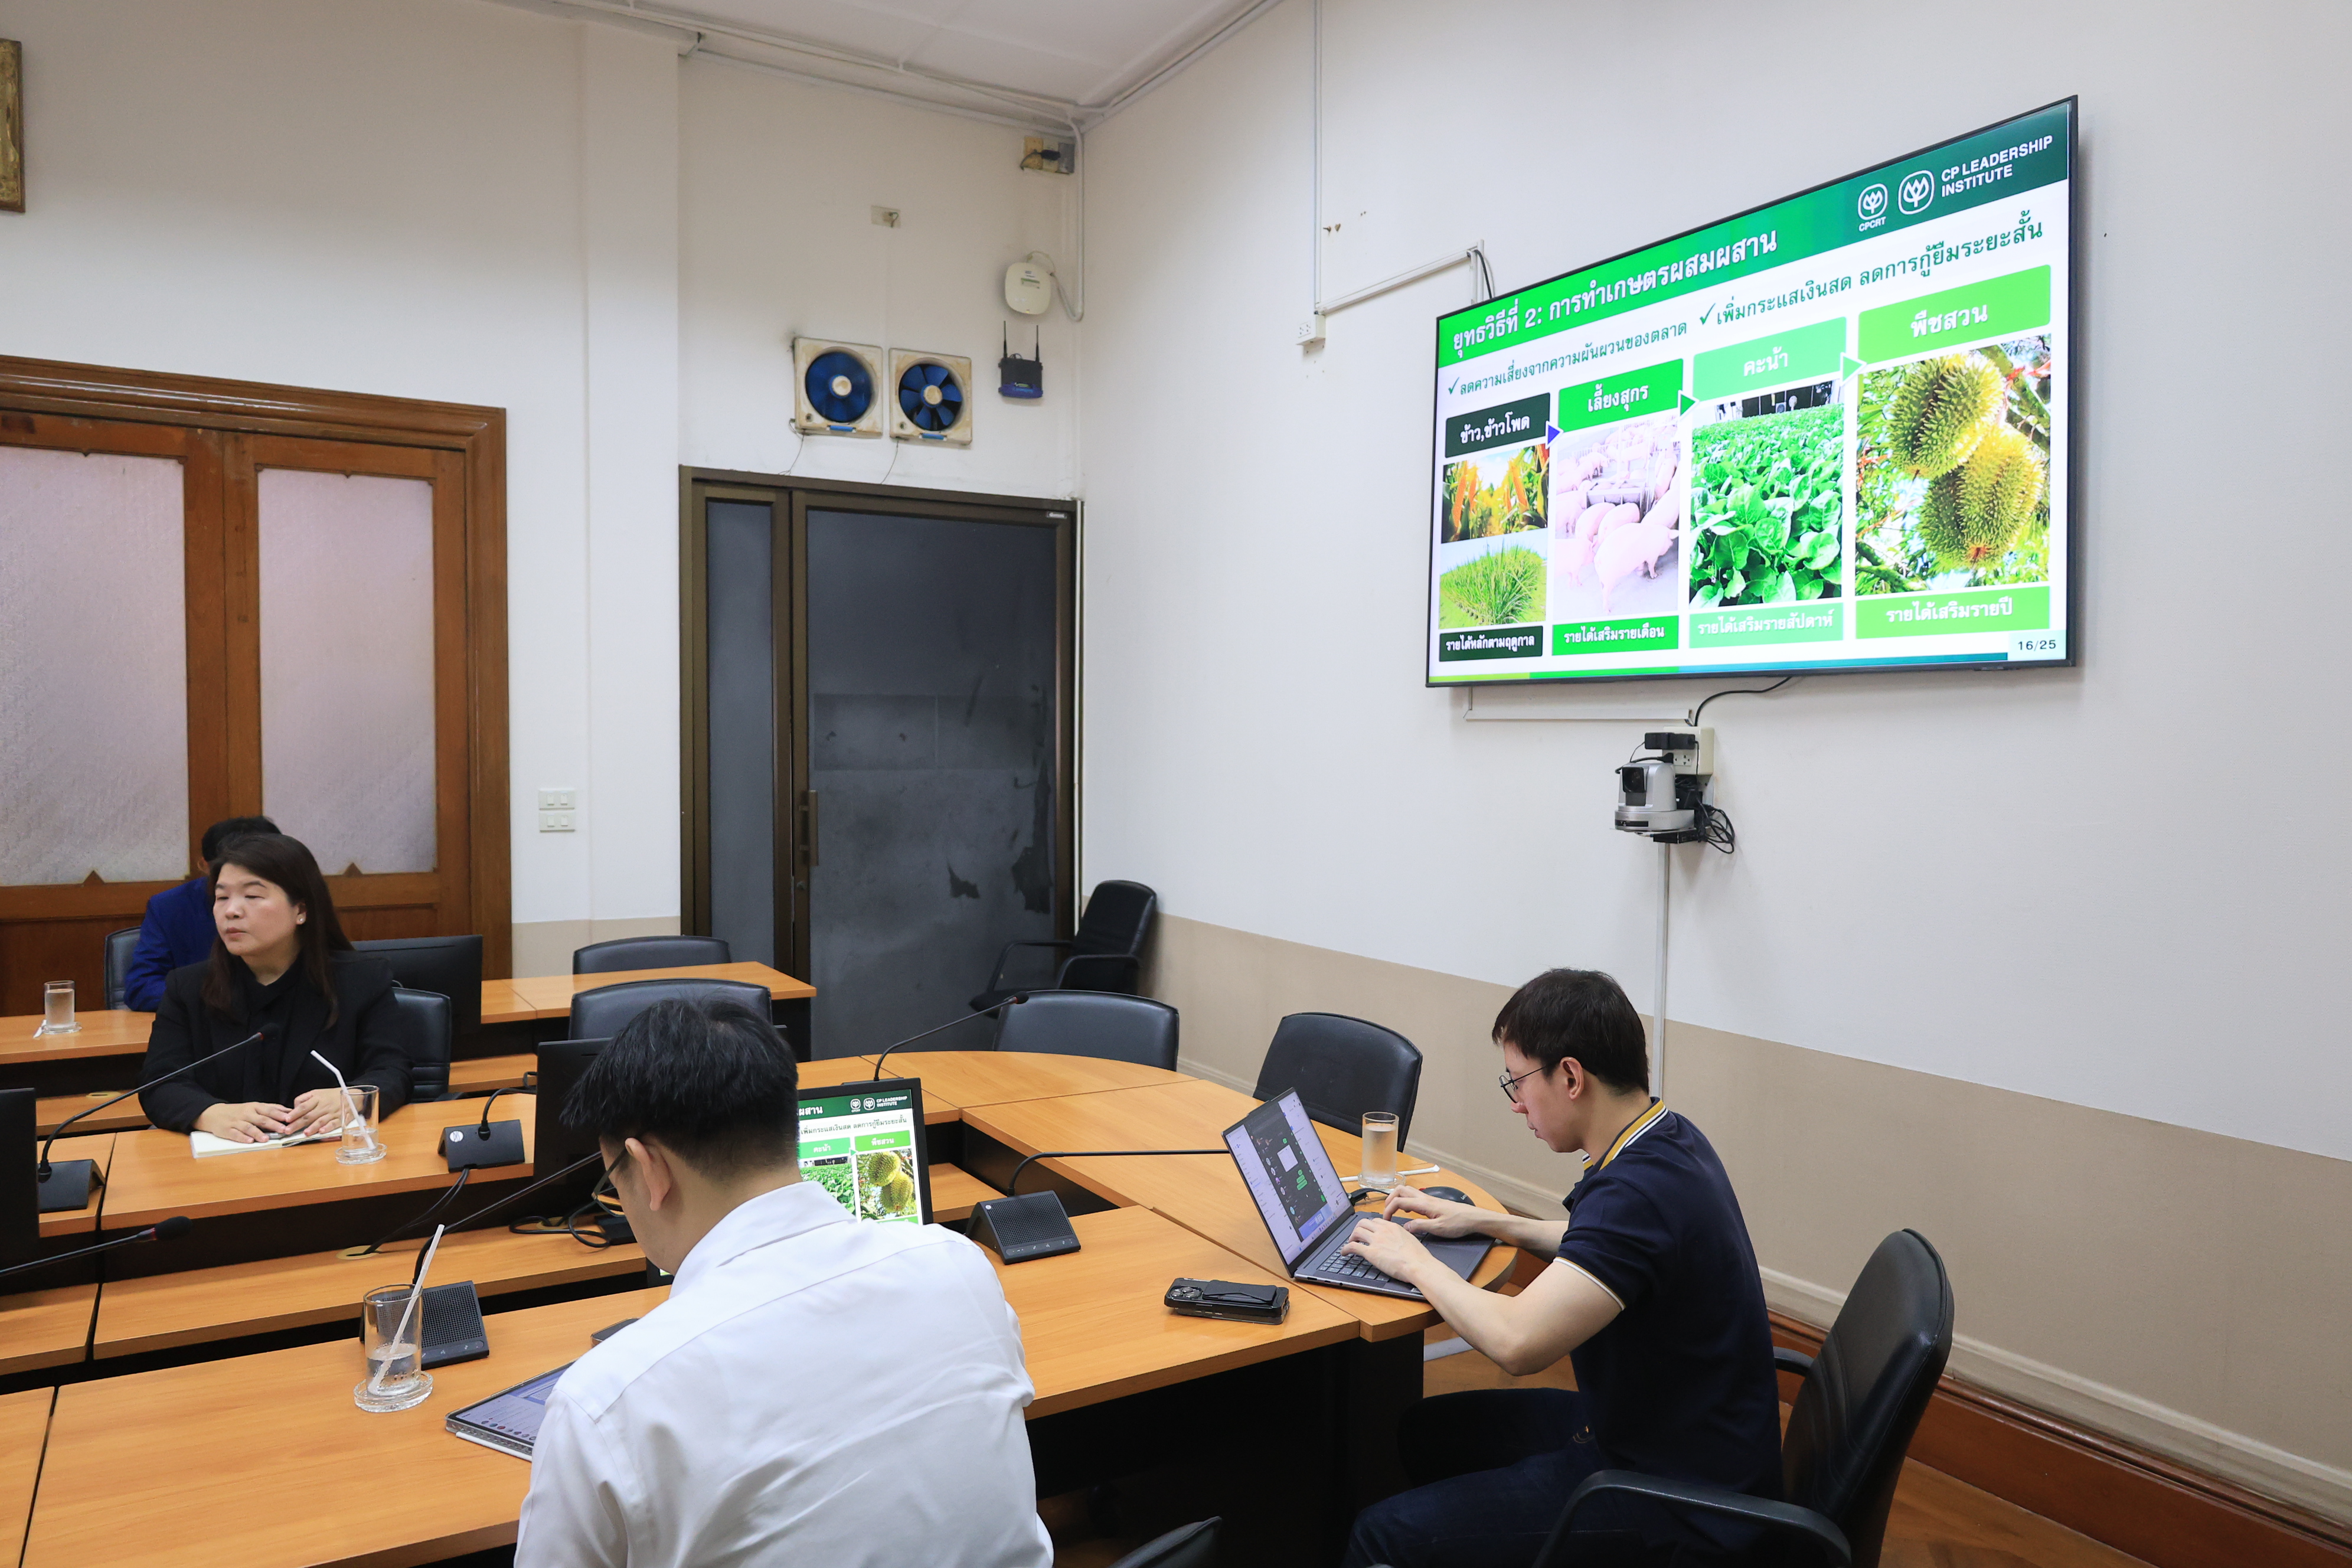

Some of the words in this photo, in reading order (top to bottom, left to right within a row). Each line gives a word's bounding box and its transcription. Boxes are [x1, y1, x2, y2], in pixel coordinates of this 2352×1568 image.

[1941, 165, 1959, 182] CP
[1962, 135, 2053, 175] LEADERSHIP
[1941, 164, 2013, 197] INSTITUTE
[1858, 217, 1886, 231] CPCRT
[1717, 275, 1852, 325] เพิ่มกระแสเงินสด
[1860, 210, 2043, 286] ลดการกู้ยืมระยะสั้น
[1453, 299, 1519, 358] ยุทธวิธีที่
[1525, 306, 1543, 328] 2:
[1549, 230, 1778, 321] การทำเกษตรผสมผสาน
[1910, 304, 1988, 338] พืชสวน
[1460, 322, 1687, 395] ลดความเสี่ยงจากความผันผวนของตลาด
[1743, 346, 1788, 377] คะน้า
[1587, 383, 1649, 412] เลี้ยงสุกร
[1697, 609, 1834, 636] รายได้เสริมรายสัปดาห์
[1886, 596, 2014, 623] รายได้เสริมรายปี
[1445, 633, 1535, 652] รายได้หลักตามฤดูกาล
[1564, 622, 1665, 644] รายได้เสริมรายเดือน
[2017, 639, 2057, 652] 16/25
